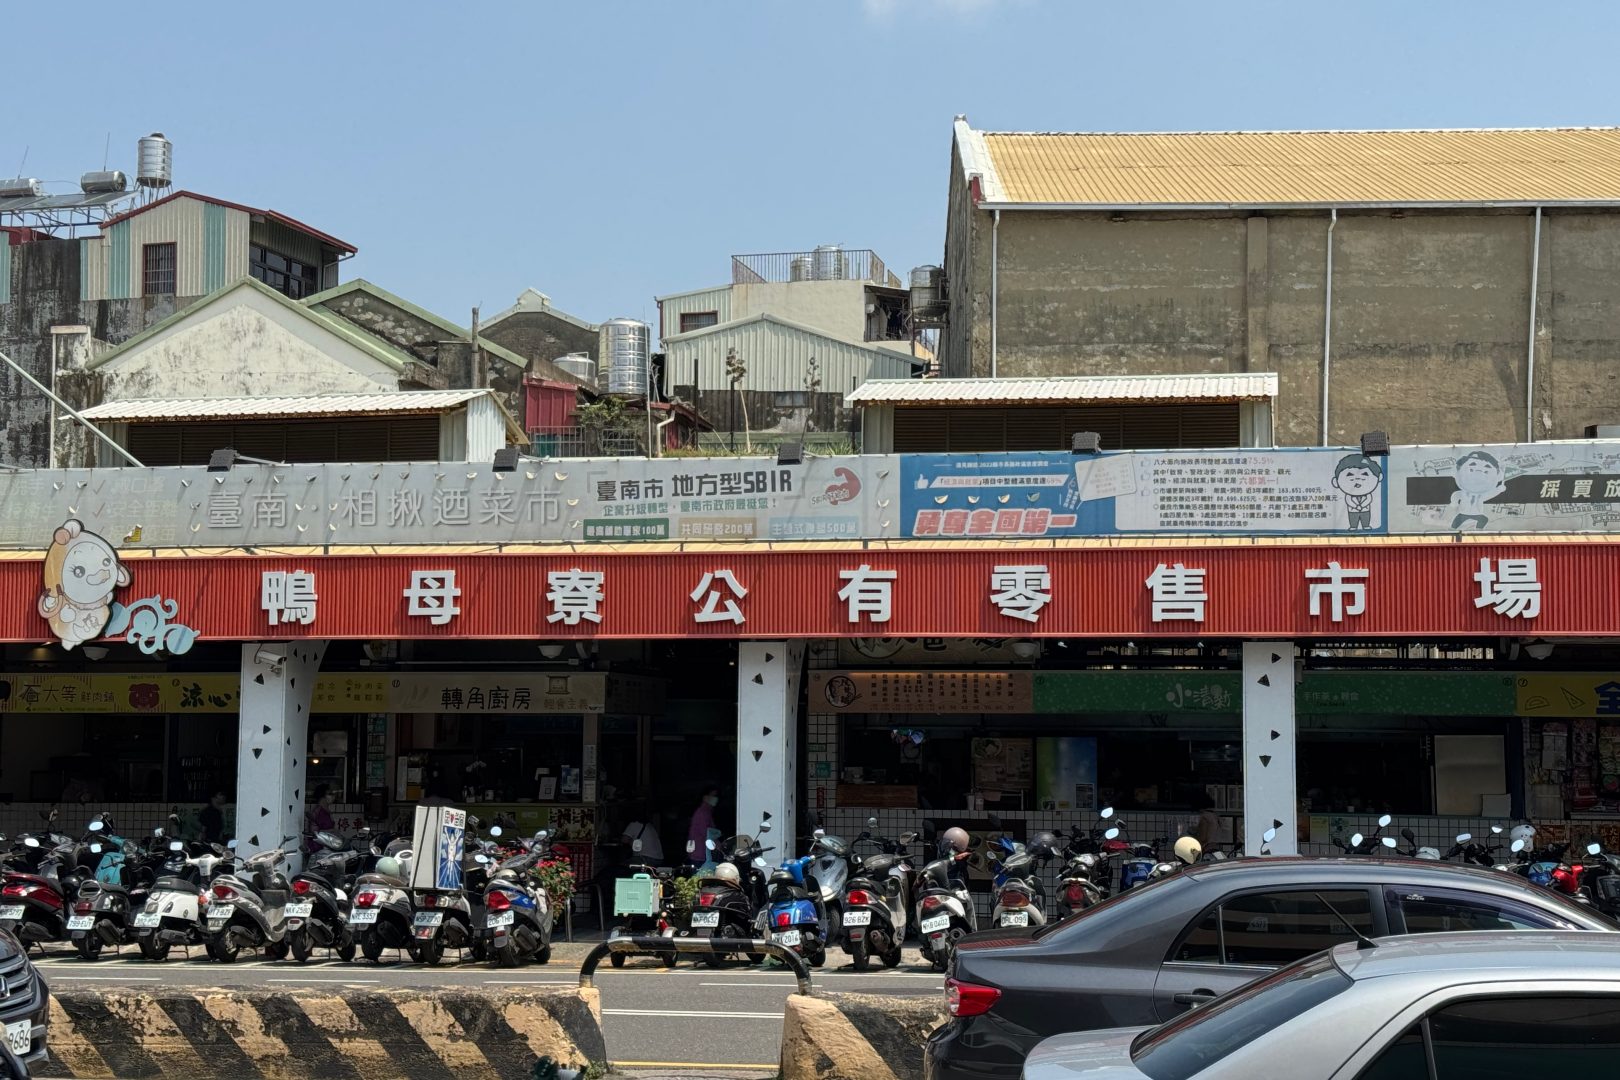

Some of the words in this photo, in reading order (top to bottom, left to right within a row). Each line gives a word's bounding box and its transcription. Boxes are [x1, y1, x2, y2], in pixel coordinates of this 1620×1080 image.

[596, 479, 664, 502] 臺南市
[671, 469, 793, 497] 地方型SBIR
[207, 489, 287, 529] 臺南
[261, 557, 1542, 627] 鴨母寮公有零售市場
[180, 683, 241, 708] 涼心
[440, 685, 532, 710] 轉角廚房
